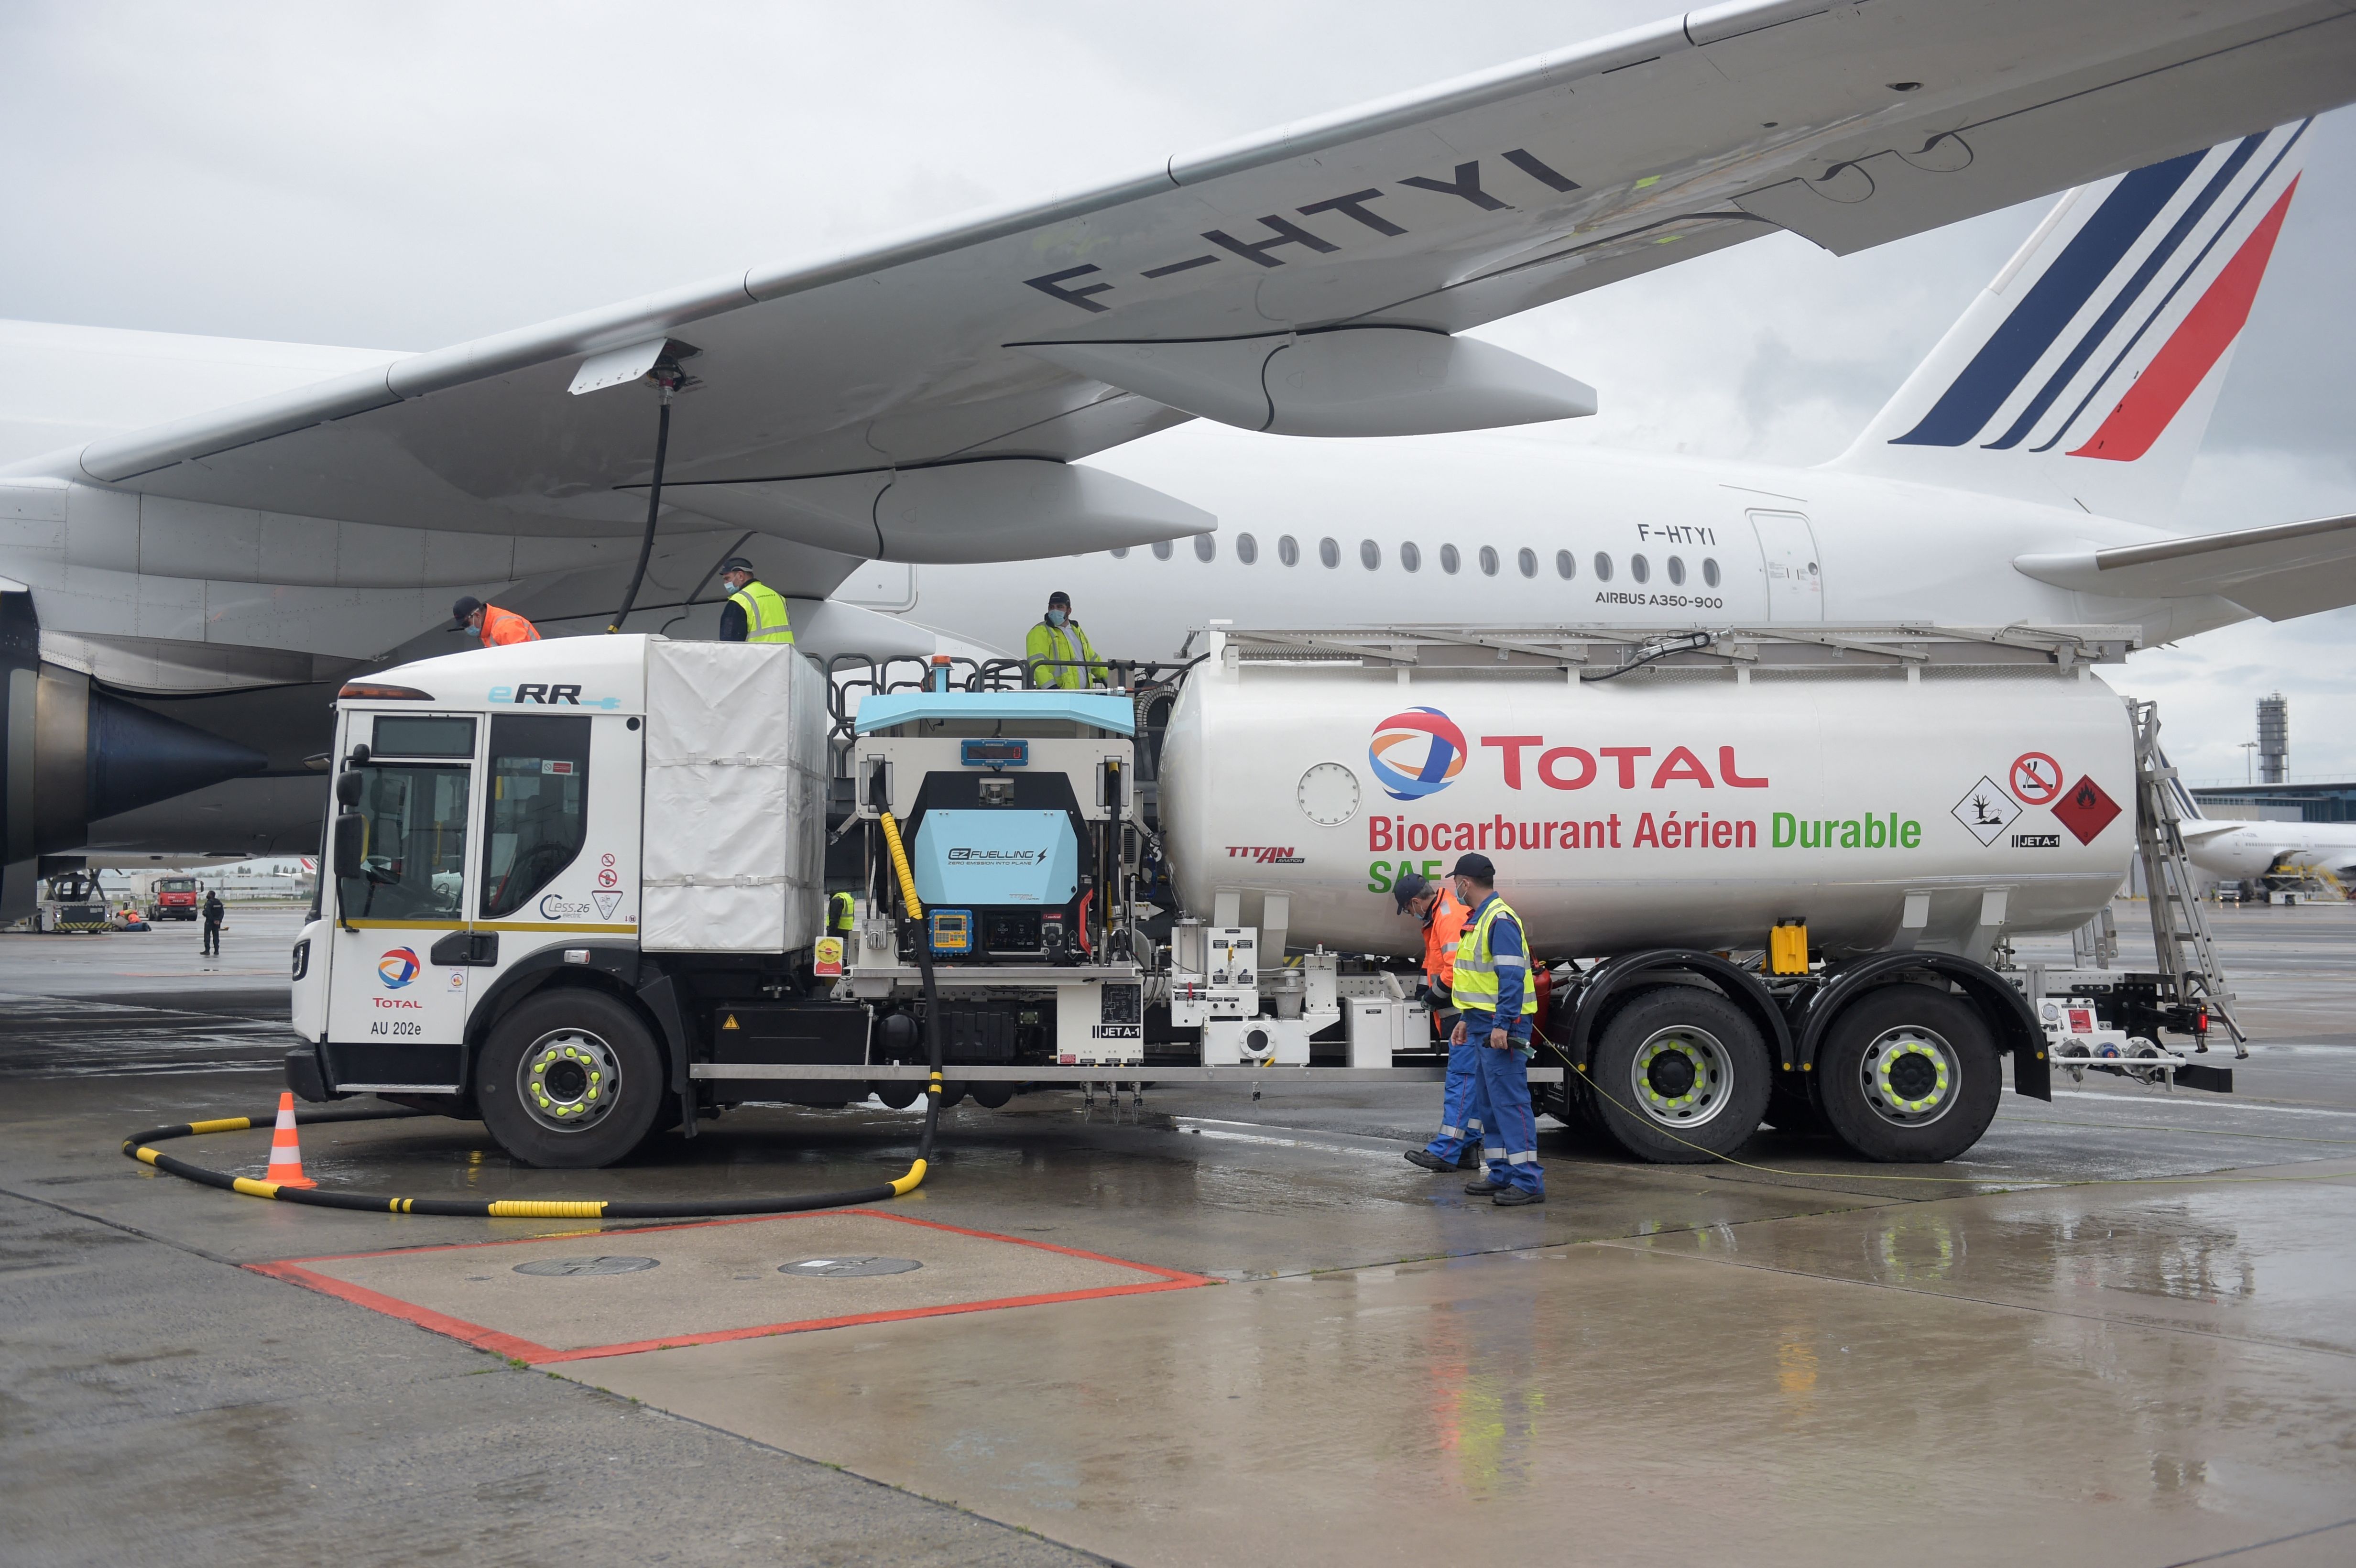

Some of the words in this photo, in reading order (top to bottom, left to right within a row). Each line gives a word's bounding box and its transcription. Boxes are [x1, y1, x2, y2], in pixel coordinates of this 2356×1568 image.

[1022, 148, 1582, 314] F-HTYI
[1637, 523, 1716, 546] F-HTYI
[1595, 592, 1646, 605] AIRBUS
[1648, 594, 1723, 609] A350-900
[1013, 747, 1021, 759] 0
[1369, 814, 1622, 852] Biocarburant
[1633, 811, 1756, 849] Aérien
[1772, 812, 1921, 849] Durable
[2021, 837, 2041, 846] JET
[2042, 837, 2059, 846] A-1
[1225, 847, 1294, 863] TITAN
[1368, 860, 1442, 893] SAF
[371, 1021, 388, 1035] AU
[393, 1021, 422, 1036] 202e
[1102, 1027, 1122, 1036] JET
[1123, 1027, 1140, 1036] A-1
